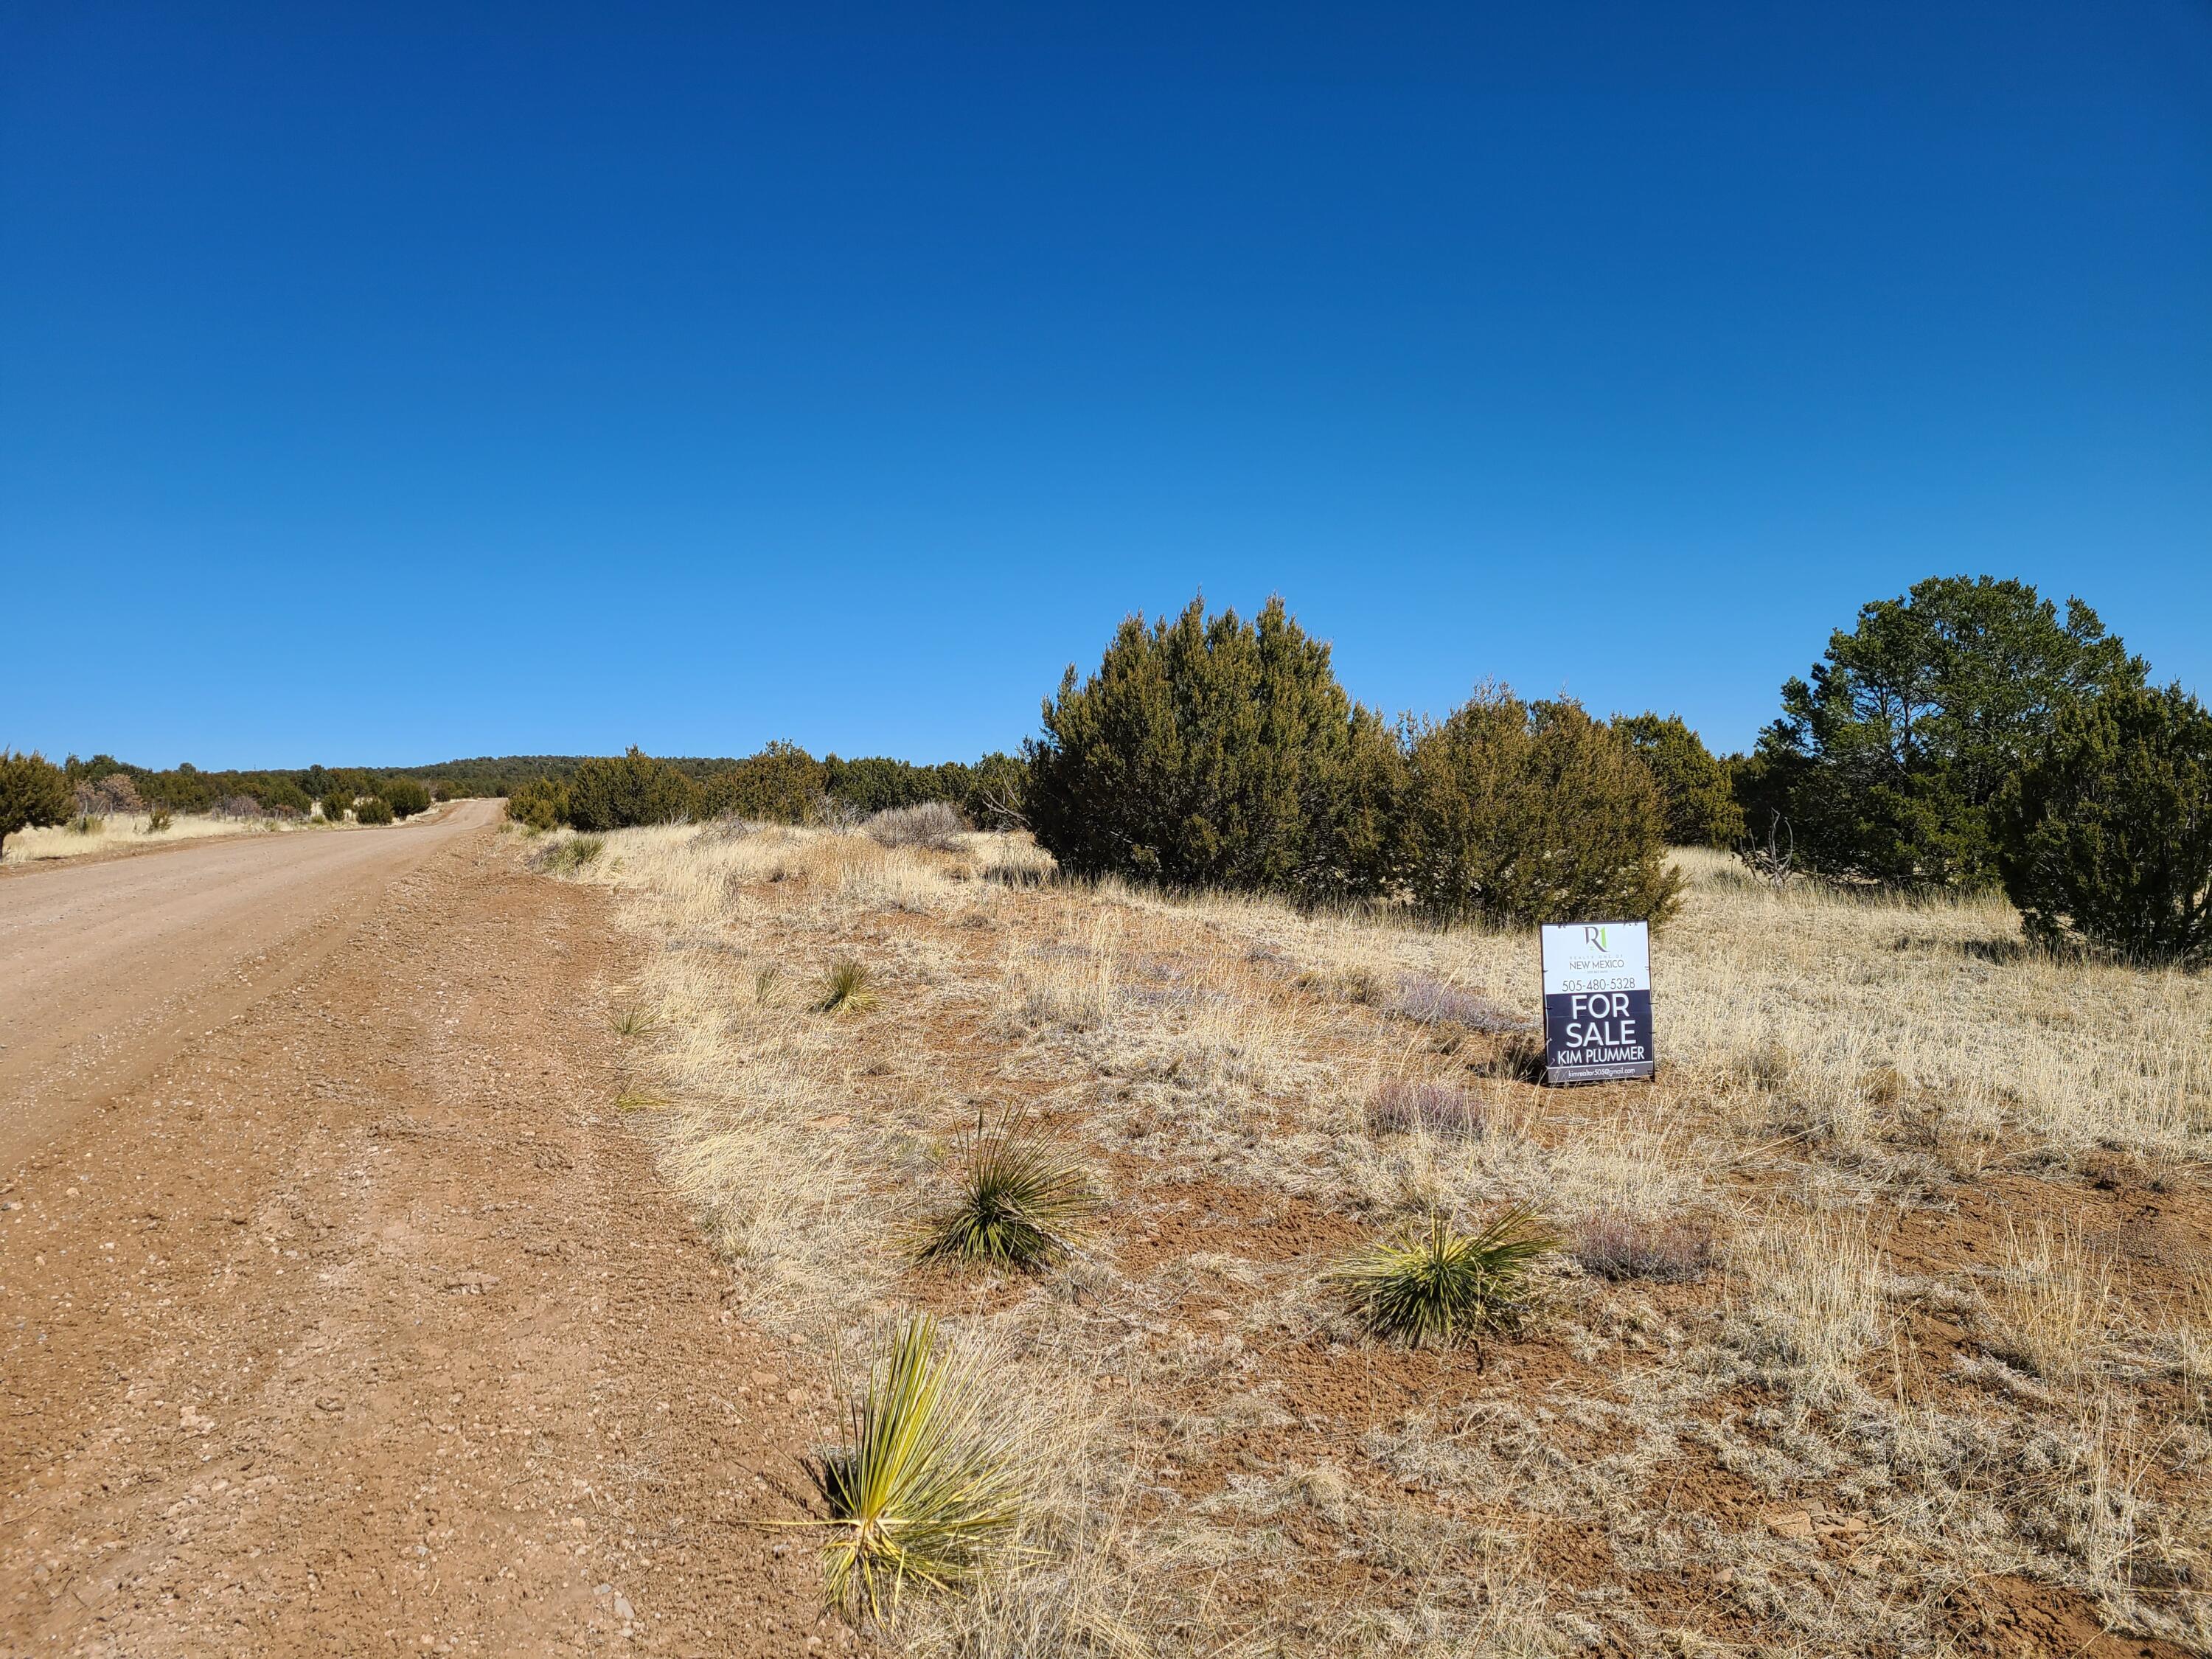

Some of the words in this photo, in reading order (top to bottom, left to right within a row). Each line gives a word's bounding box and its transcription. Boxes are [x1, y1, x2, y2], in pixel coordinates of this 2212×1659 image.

[1569, 961, 1590, 970] NEW
[1592, 959, 1624, 970] MEXICO
[1562, 977, 1635, 992] 505-480-5328
[1571, 993, 1630, 1020] FOR
[1565, 1020, 1637, 1048] SALE
[1557, 1050, 1582, 1065] KIM
[1586, 1046, 1645, 1063] PLUMMER
